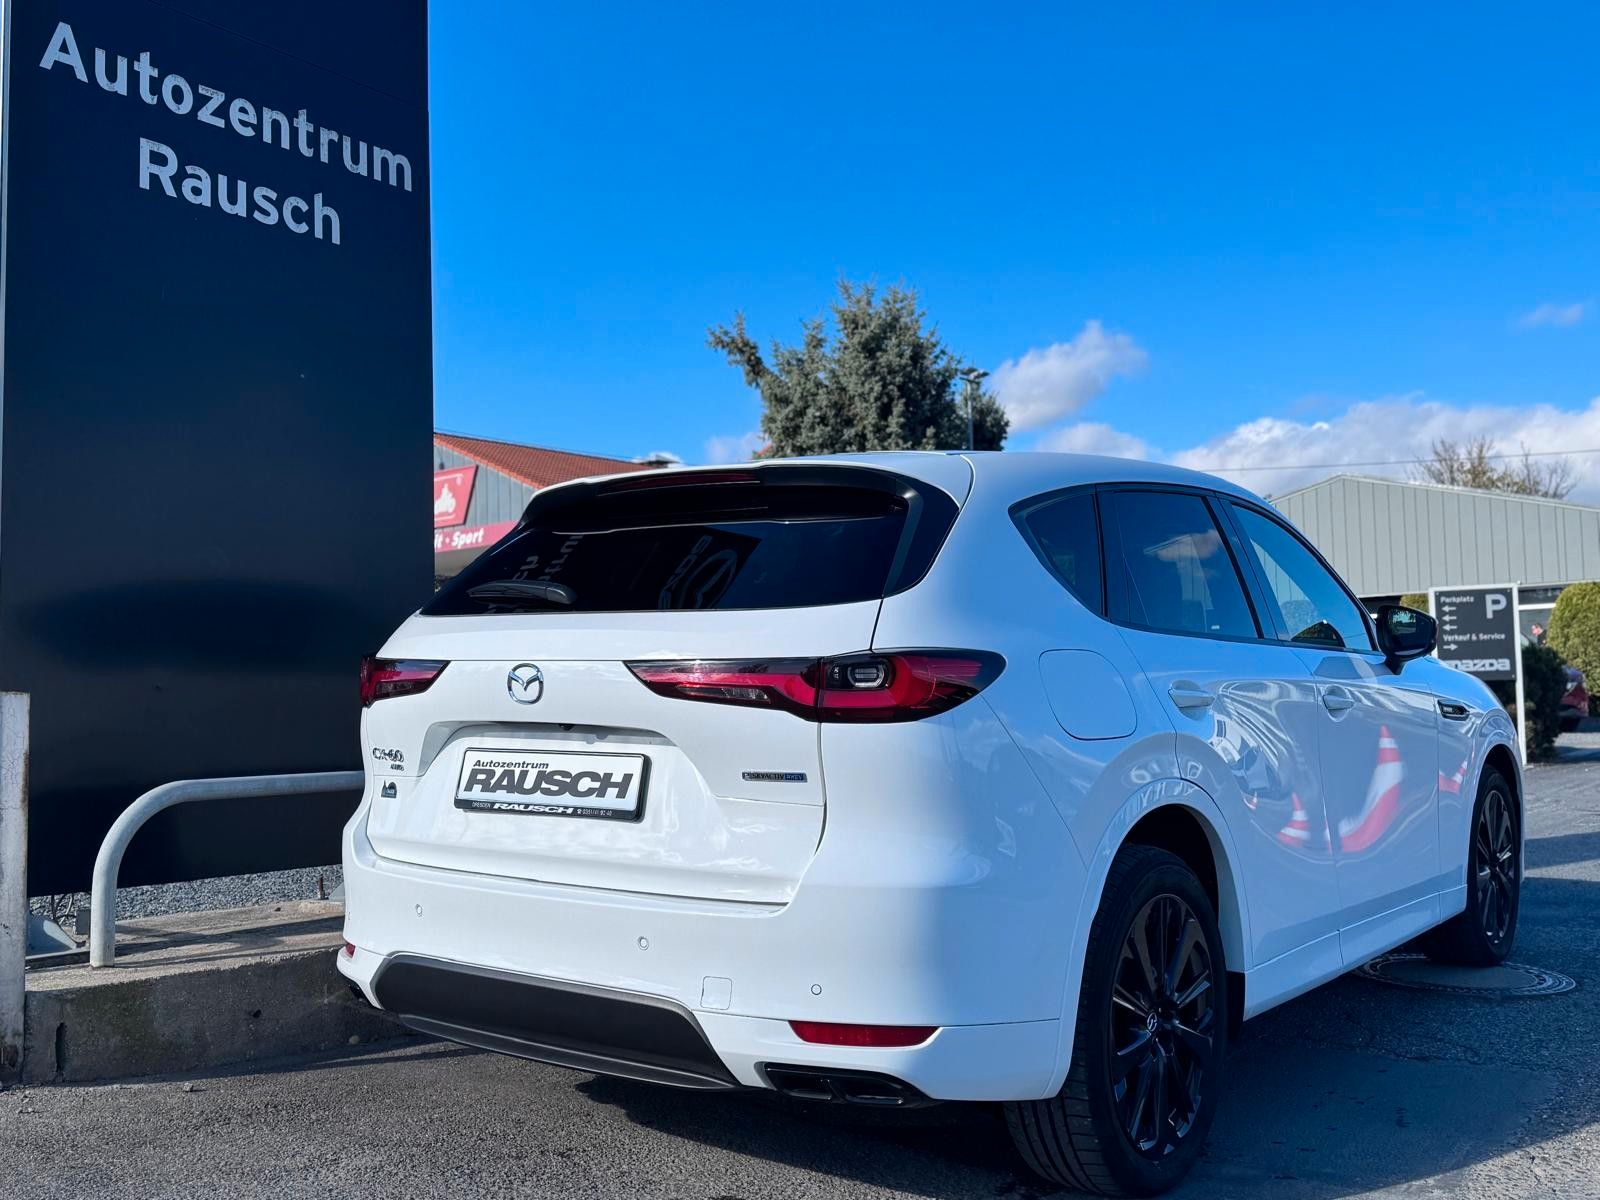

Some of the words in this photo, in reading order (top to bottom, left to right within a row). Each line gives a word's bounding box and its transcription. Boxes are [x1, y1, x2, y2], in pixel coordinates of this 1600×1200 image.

[38, 20, 413, 193] Autozentrum
[138, 137, 341, 245] Rausch
[451, 528, 484, 549] Sport
[1440, 595, 1475, 604] Parkplatz
[1485, 593, 1507, 619] P
[1442, 633, 1471, 642] Verkauf
[1478, 632, 1506, 641] Service
[473, 759, 549, 769] Autozentrum
[464, 768, 634, 799] RAUSCH
[493, 802, 574, 815] RAUSCH
